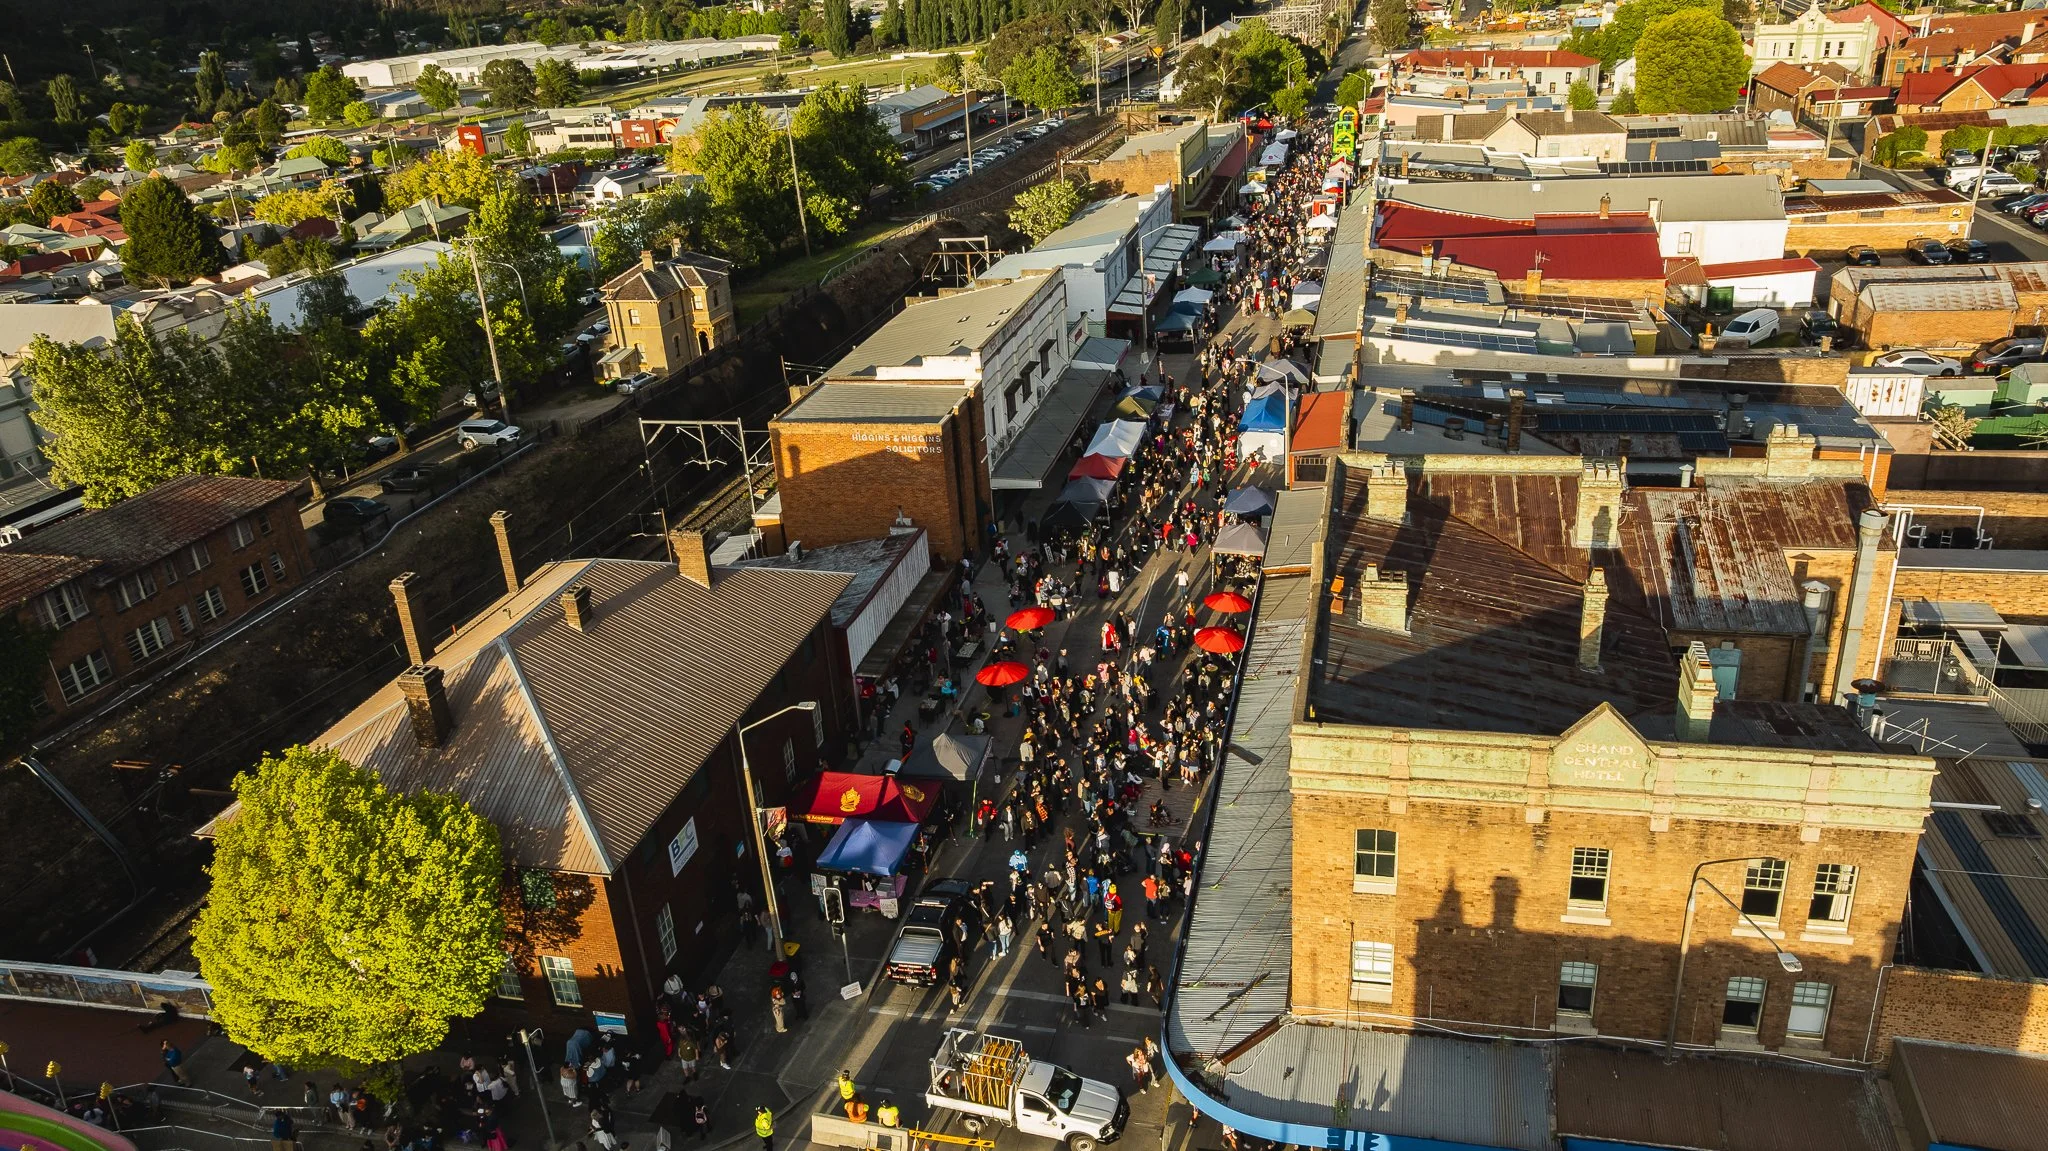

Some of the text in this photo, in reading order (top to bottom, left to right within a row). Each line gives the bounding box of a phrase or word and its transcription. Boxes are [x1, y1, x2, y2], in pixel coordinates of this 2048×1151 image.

[852, 433, 942, 443] HIGGINS & HIGGINS
[886, 445, 942, 454] SOLICITORS
[1575, 743, 1634, 755] GRAND
[1564, 756, 1641, 769] CENTRAL
[1574, 770, 1624, 782] HOTEL
